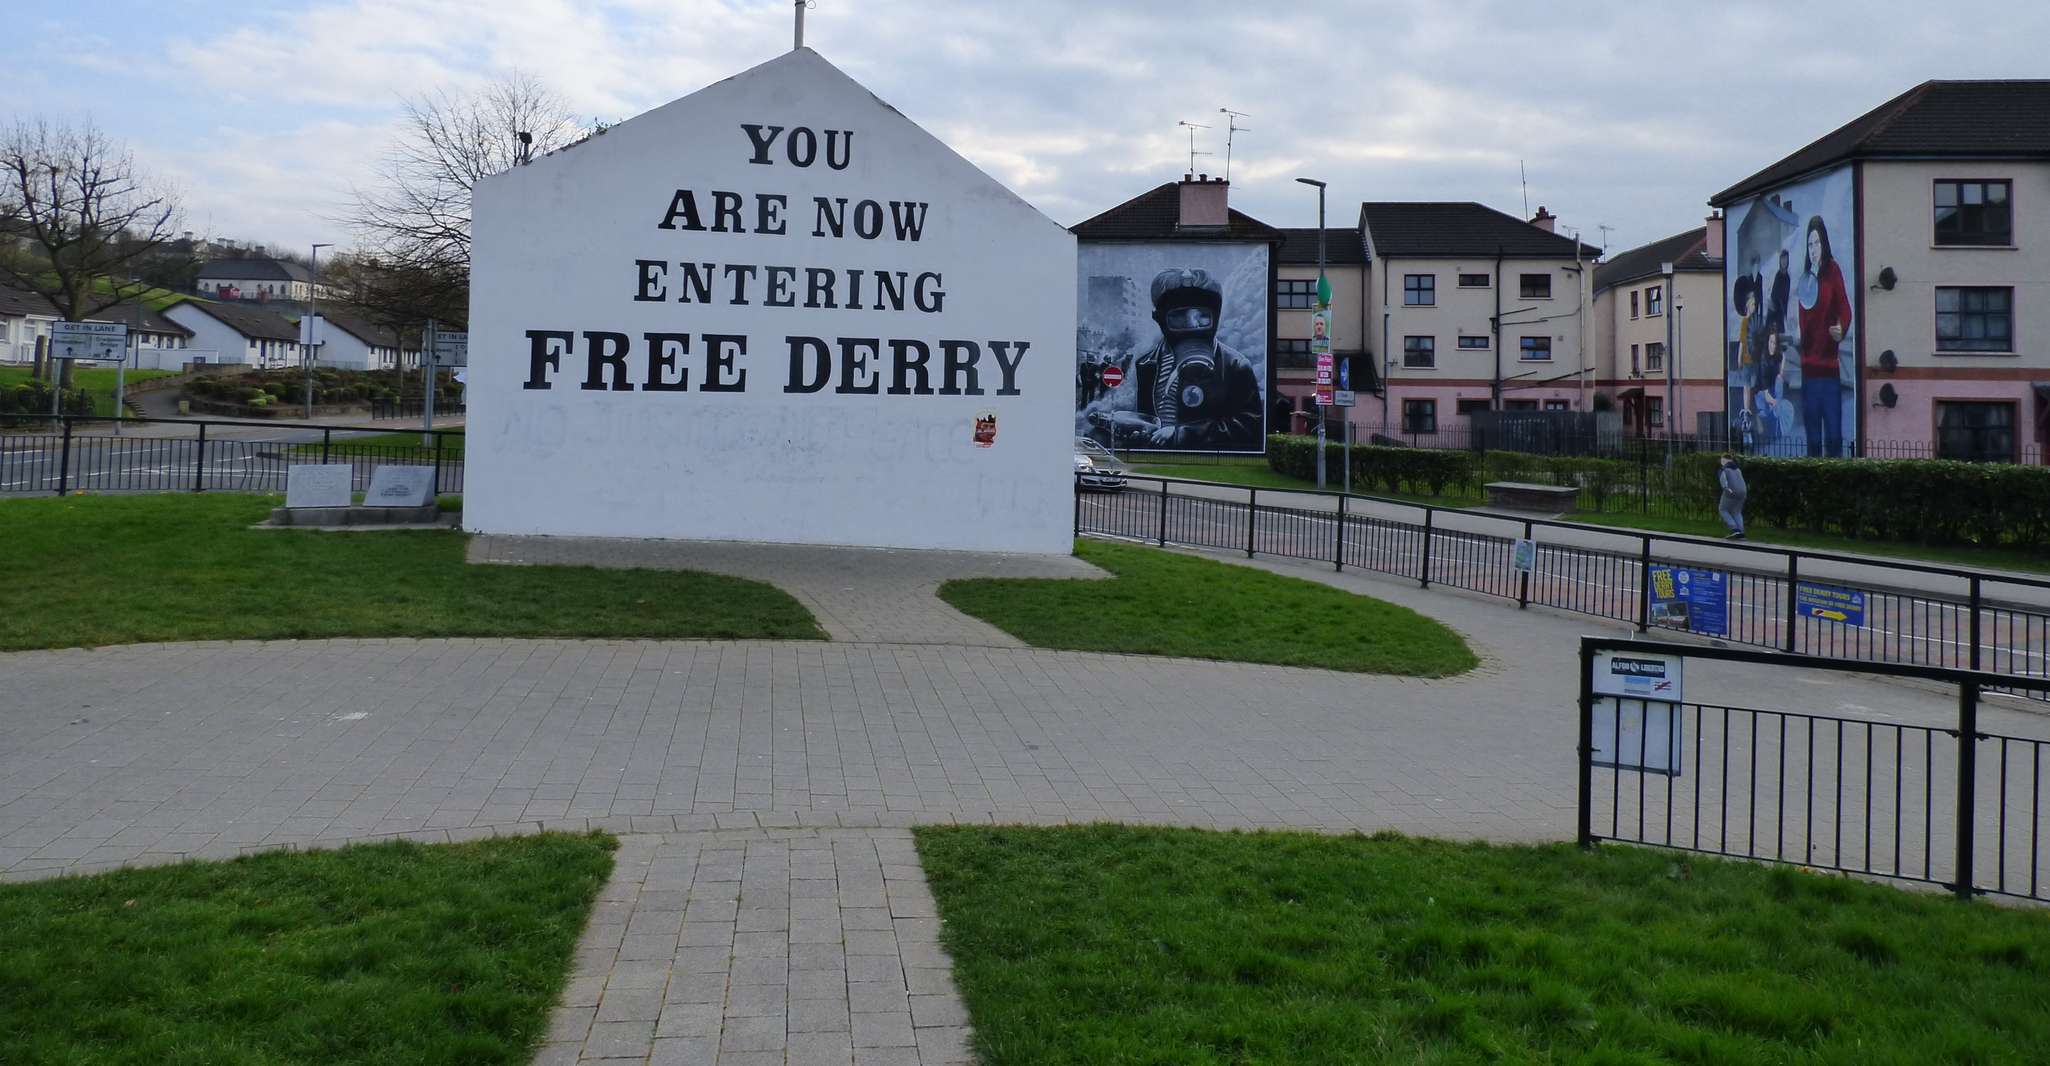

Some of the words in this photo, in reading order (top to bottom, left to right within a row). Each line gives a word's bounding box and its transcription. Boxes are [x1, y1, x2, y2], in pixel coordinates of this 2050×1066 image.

[741, 124, 854, 170] YOU
[658, 189, 787, 236] ARE
[812, 197, 929, 242] NOW
[634, 260, 945, 314] ENTERING
[523, 330, 747, 392] FREE
[784, 336, 1031, 396] DERRY
[1652, 569, 1672, 584] FREE
